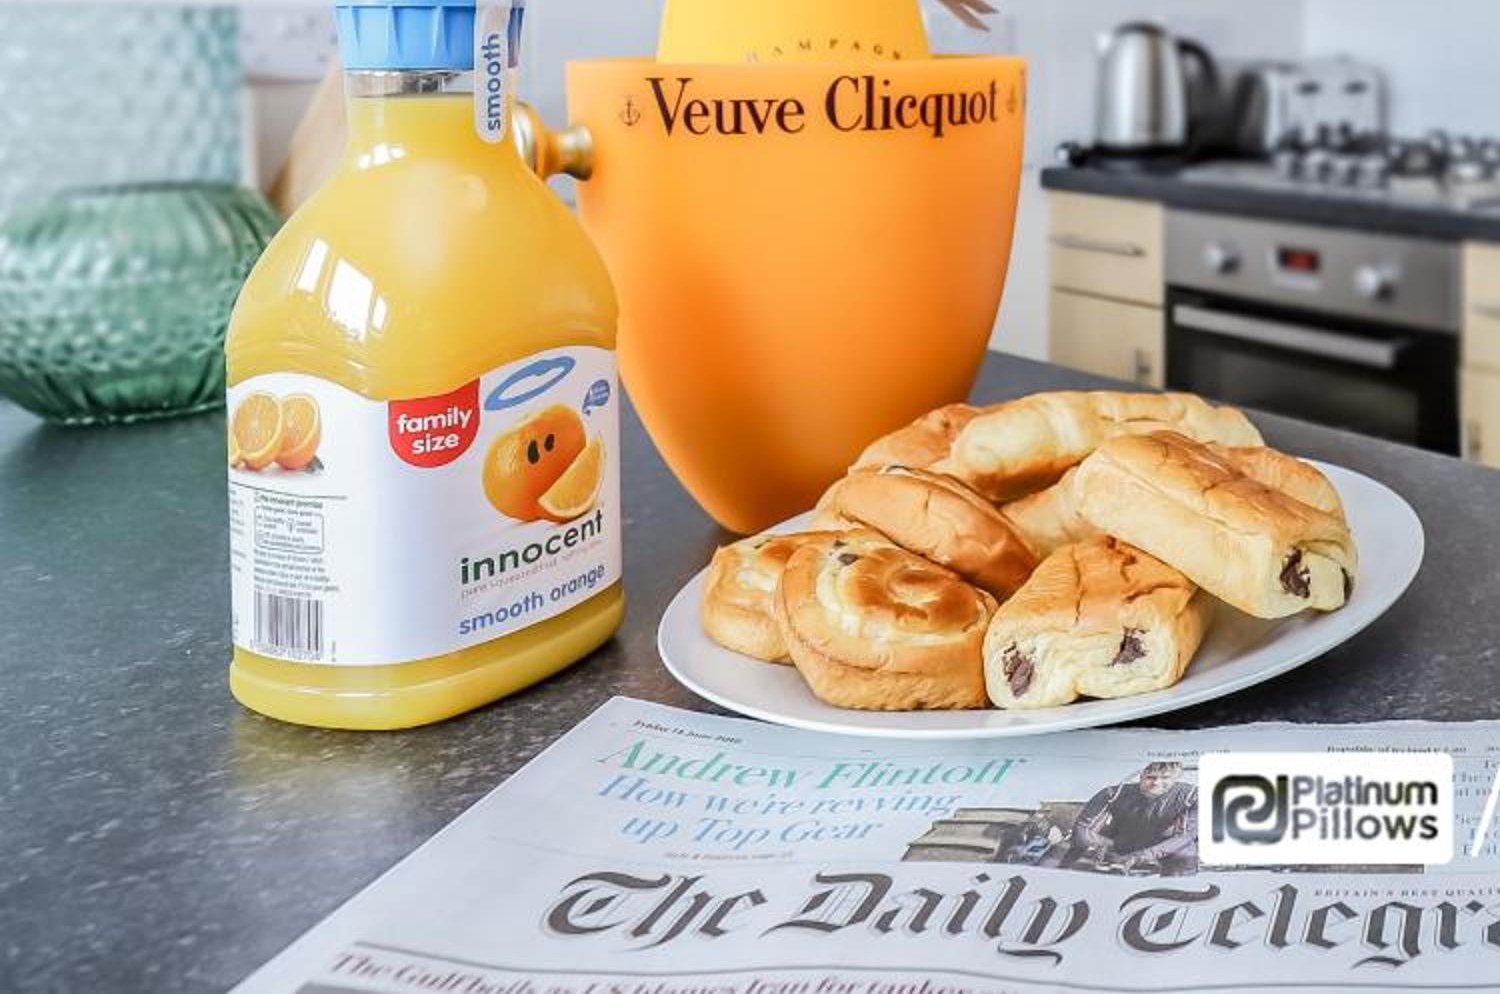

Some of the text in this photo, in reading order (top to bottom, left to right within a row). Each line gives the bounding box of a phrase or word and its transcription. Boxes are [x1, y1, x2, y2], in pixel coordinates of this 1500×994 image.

[745, 37, 902, 62] HAMPAGN
[482, 33, 501, 131] smooth
[645, 74, 999, 138] Veuve Clicquot
[397, 406, 473, 434] family
[412, 433, 460, 455] size
[461, 509, 604, 585] innocent
[459, 564, 606, 635] smooth orange
[597, 740, 1027, 789] Andrew Flintoff
[598, 774, 963, 817] How we're revving
[622, 816, 884, 850] up Top Gear
[541, 869, 769, 949] The
[762, 869, 1093, 967] Daily
[331, 952, 391, 977] The
